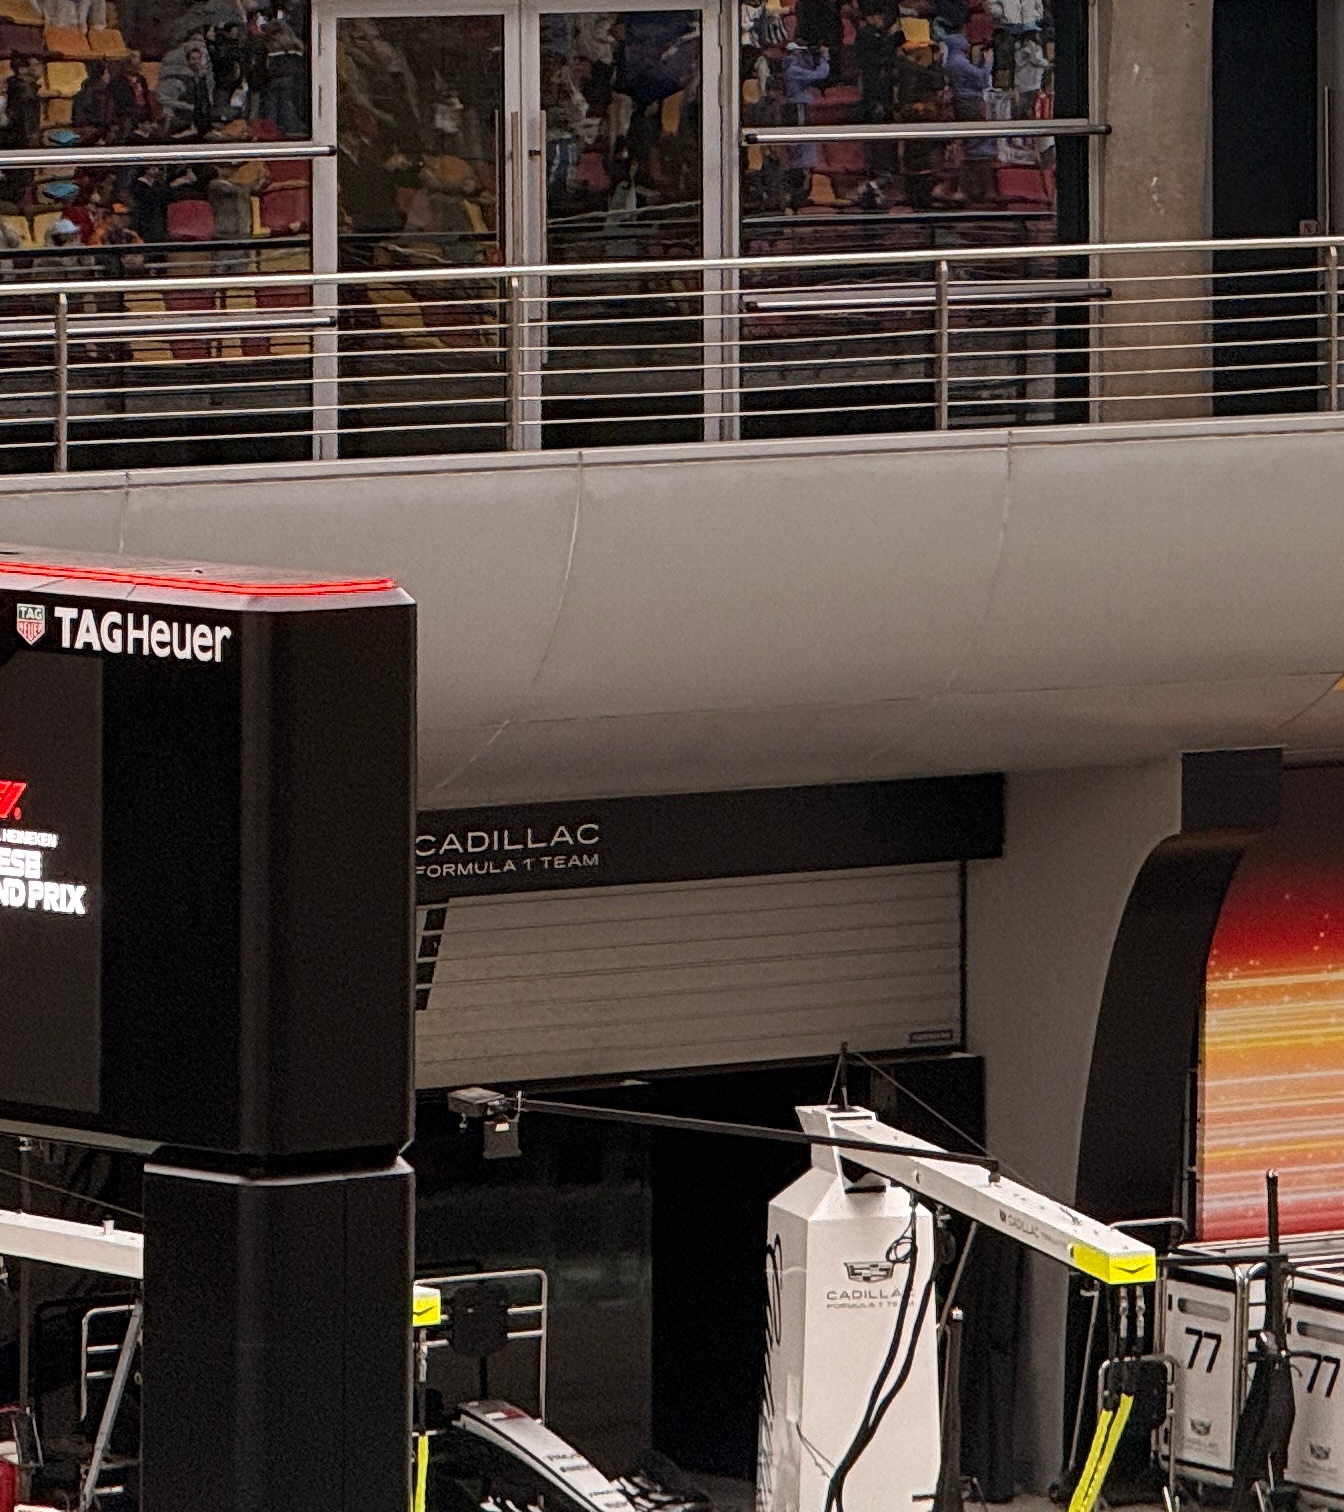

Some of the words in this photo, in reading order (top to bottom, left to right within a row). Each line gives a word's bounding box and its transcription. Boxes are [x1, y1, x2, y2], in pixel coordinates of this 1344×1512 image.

[19, 605, 43, 621] TAG
[415, 823, 600, 857] CADILLAC
[523, 858, 533, 871] 1
[540, 853, 600, 870] TEAM
[28, 880, 87, 915] PRIX
[826, 1286, 915, 1301] CADILLA
[1184, 1327, 1222, 1374] 77
[1302, 1352, 1341, 1399] 77
